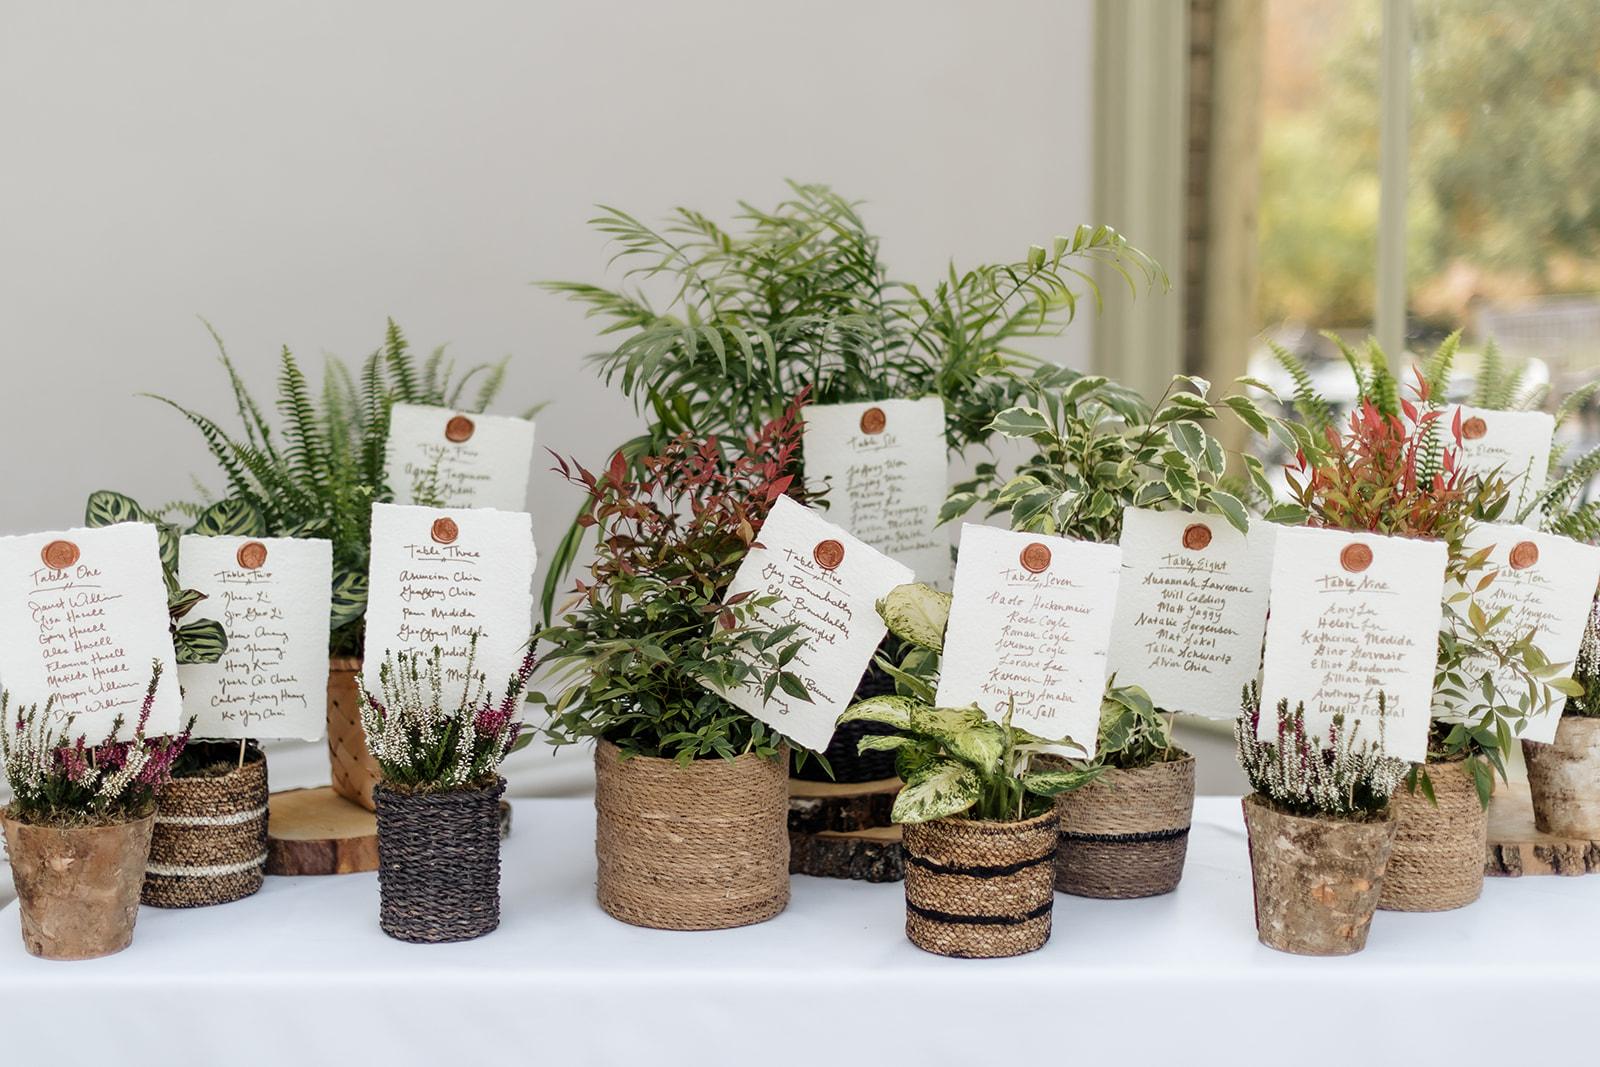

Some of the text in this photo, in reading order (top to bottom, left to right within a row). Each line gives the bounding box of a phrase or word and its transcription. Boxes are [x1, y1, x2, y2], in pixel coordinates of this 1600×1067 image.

[403, 543, 481, 559] Table Three
[782, 548, 816, 570] Table
[1161, 553, 1227, 574] Table Eight
[30, 564, 102, 586] Table One
[214, 569, 273, 583] Table Two
[999, 567, 1084, 588] Table Seven
[1315, 574, 1391, 591] Table Nine
[1156, 601, 1184, 614] Matt
[1134, 612, 1178, 627] Natalie
[1145, 641, 1176, 655] Talia
